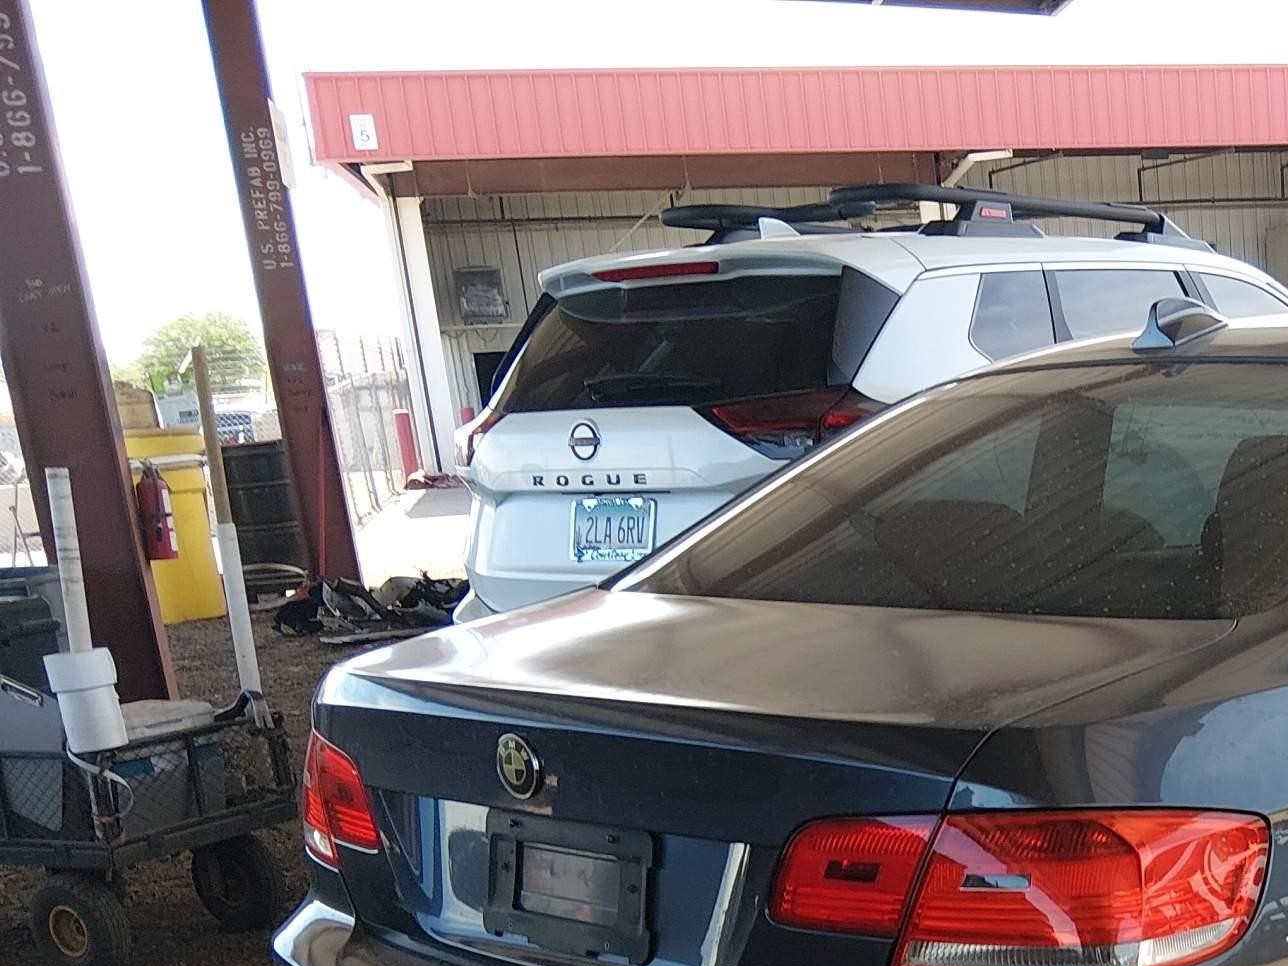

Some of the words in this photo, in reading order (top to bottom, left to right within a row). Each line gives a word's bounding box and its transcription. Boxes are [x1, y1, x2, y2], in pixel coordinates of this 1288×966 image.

[360, 129, 370, 142] 5
[247, 166, 270, 230] PREFAB
[257, 127, 294, 268] 1-866-799-0969
[532, 473, 648, 487] ROGUE
[585, 516, 612, 543] 2LA
